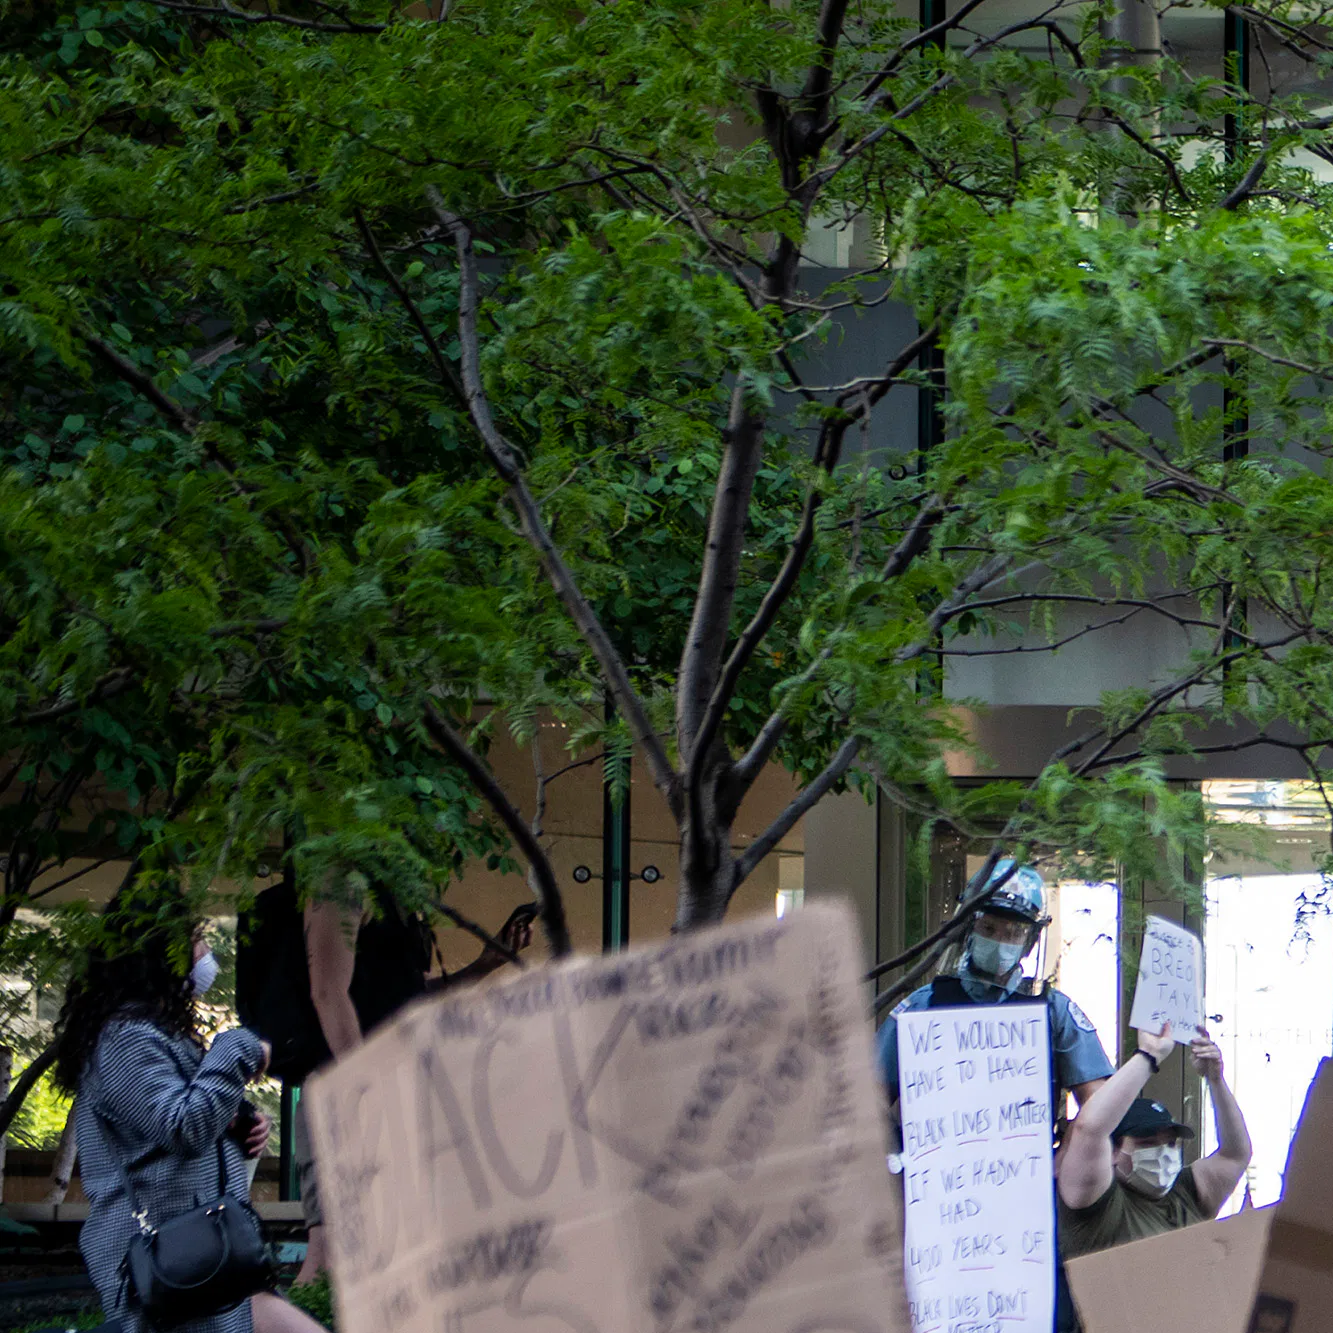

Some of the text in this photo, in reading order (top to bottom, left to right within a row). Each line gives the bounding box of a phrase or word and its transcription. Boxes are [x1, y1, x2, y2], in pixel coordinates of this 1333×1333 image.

[908, 1020, 942, 1055] WE
[905, 1055, 1039, 1104] HAVE TO HAVE
[905, 1097, 1049, 1157] BLACK LIVES MATTER
[908, 1167, 931, 1206] IF
[940, 1163, 965, 1194] WE
[939, 1198, 982, 1225] HAD
[952, 1234, 1008, 1262] YEARS
[1022, 1230, 1045, 1255] OF
[910, 1297, 941, 1328] BLACK
[949, 1294, 981, 1321] LIVES
